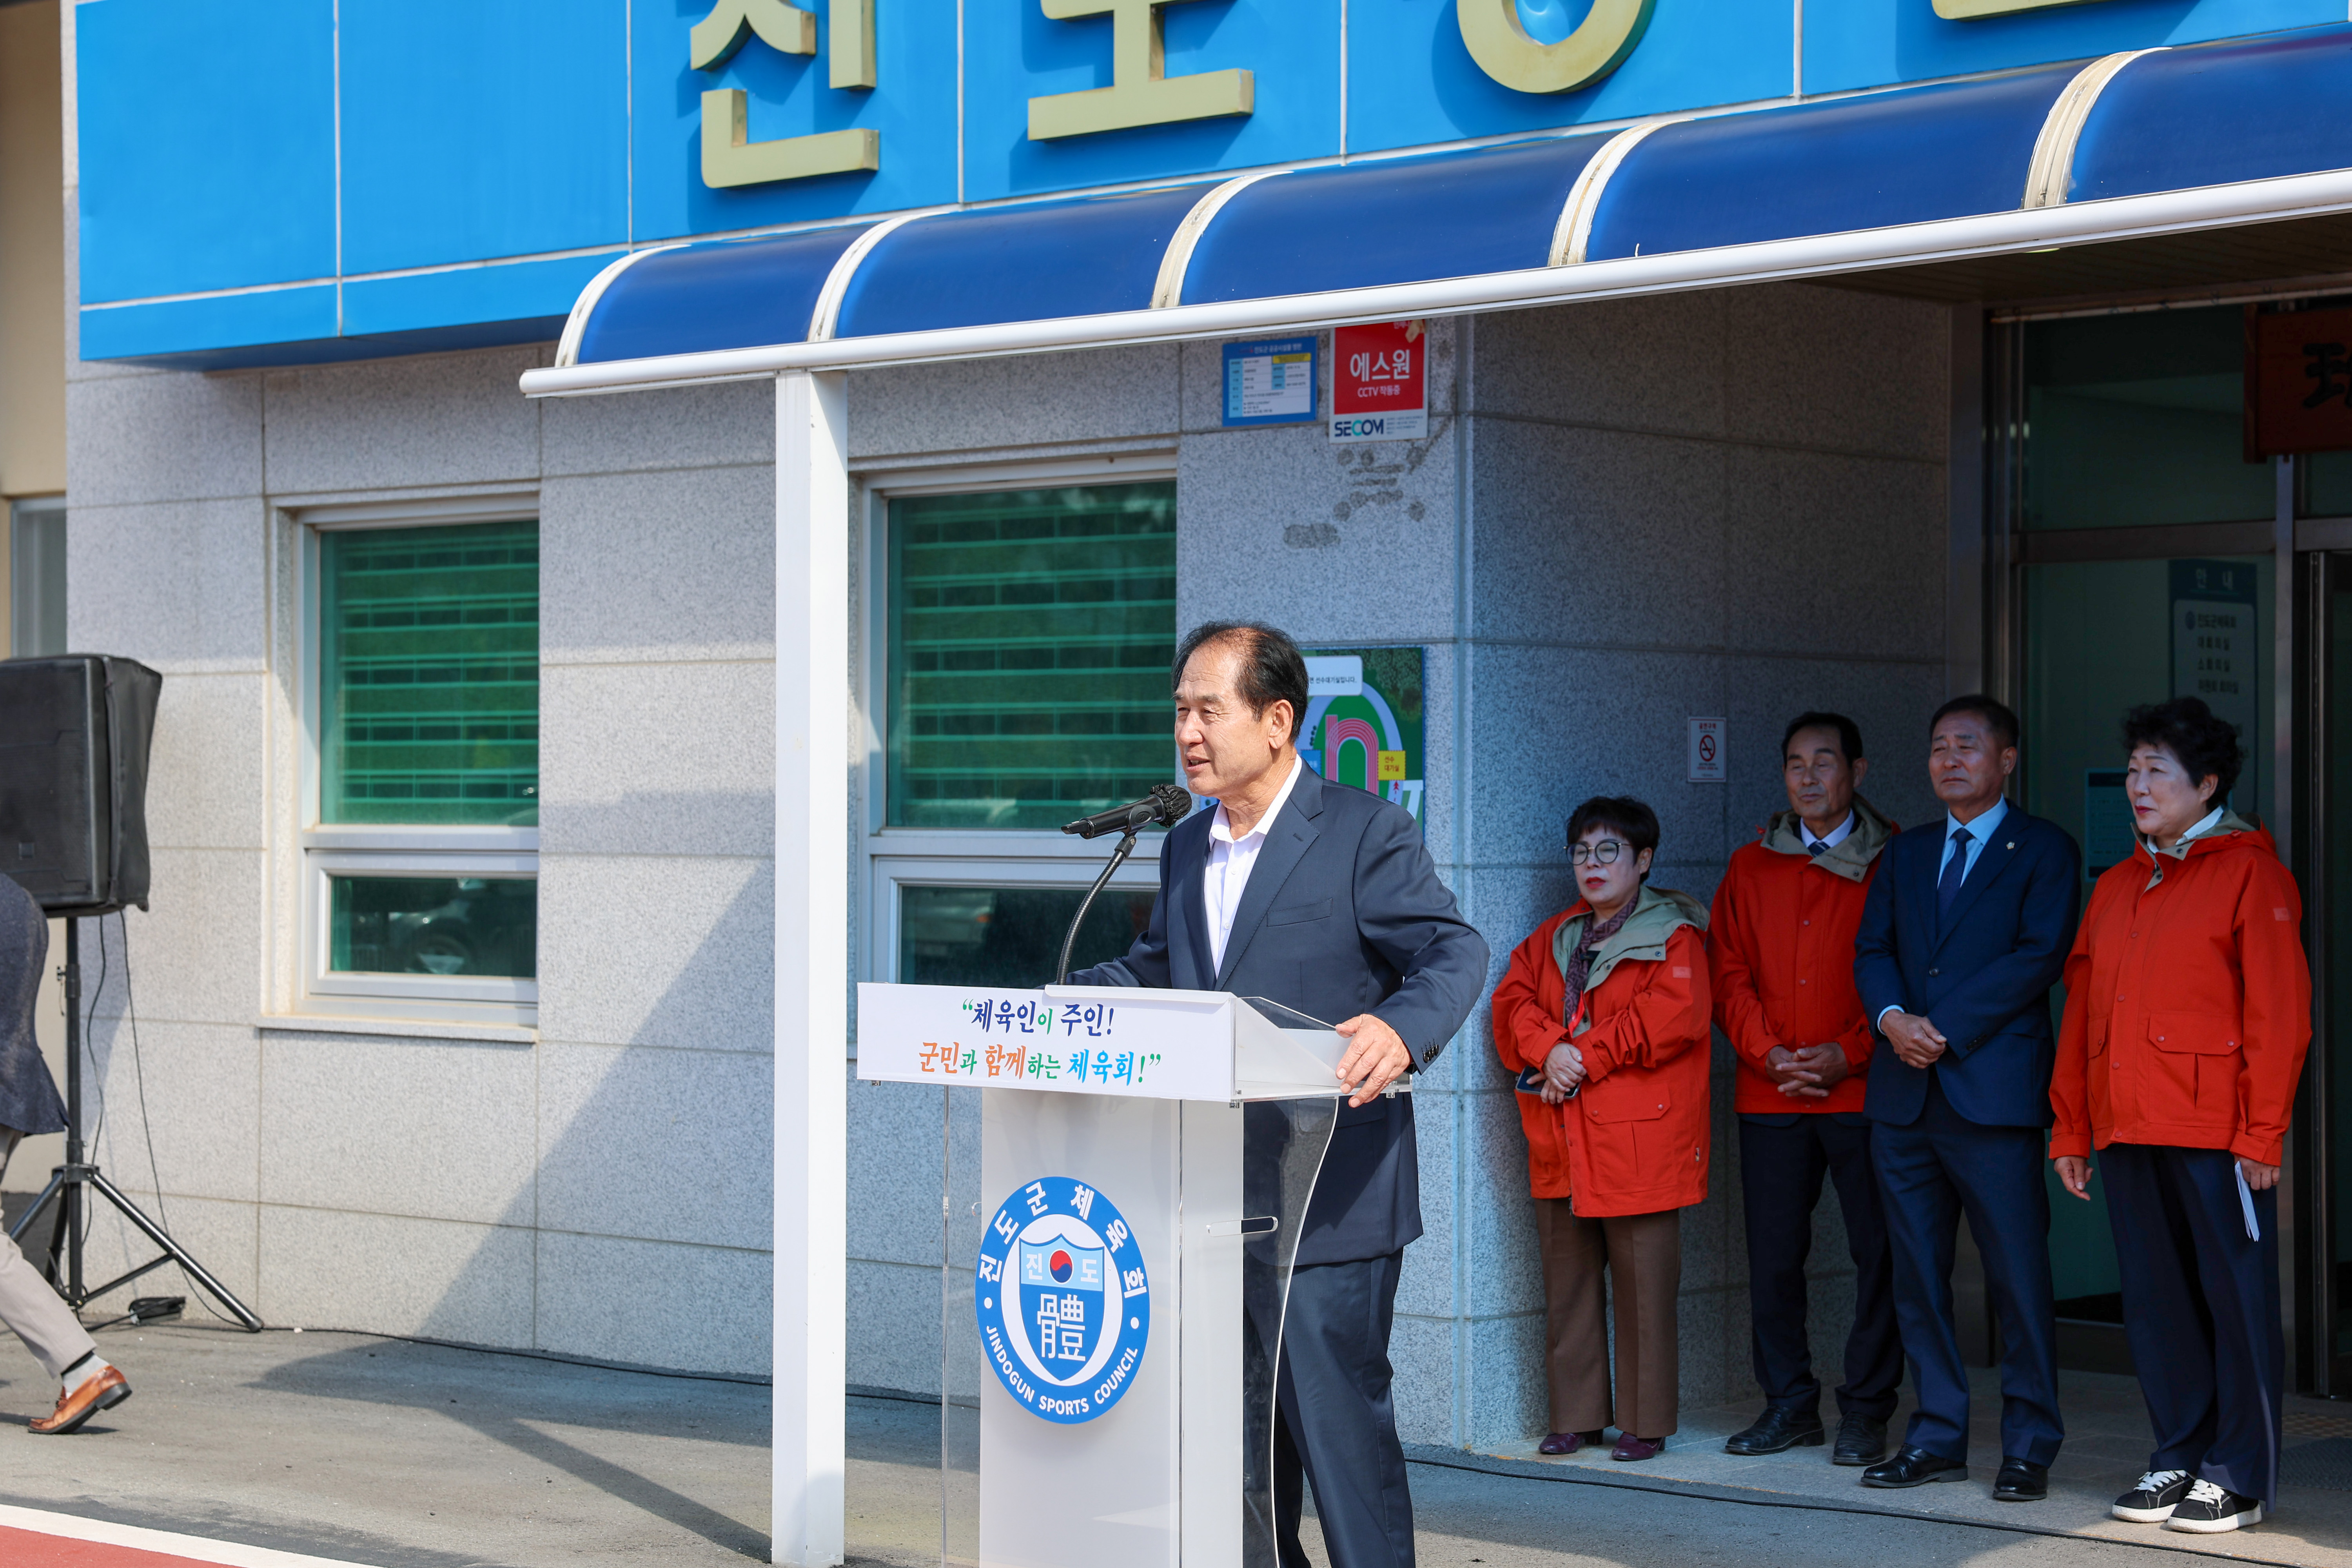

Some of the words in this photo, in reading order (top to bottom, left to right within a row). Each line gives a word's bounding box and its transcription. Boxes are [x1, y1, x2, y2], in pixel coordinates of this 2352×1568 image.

[1350, 349, 1410, 382] 에스원
[1357, 386, 1379, 397] CCTV
[1334, 419, 1384, 437] SECOM
[962, 998, 1053, 1034] “체육인이
[1061, 1003, 1114, 1036] 주인!
[919, 1042, 977, 1076] 군민과
[985, 1044, 1061, 1080] 함께하는
[1066, 1049, 1161, 1086] 체육회!”
[1037, 1293, 1085, 1361] 體
[986, 1325, 1034, 1403] JINDOGUN
[1039, 1395, 1089, 1415] SPORTS
[1094, 1348, 1138, 1405] COUNCIL
